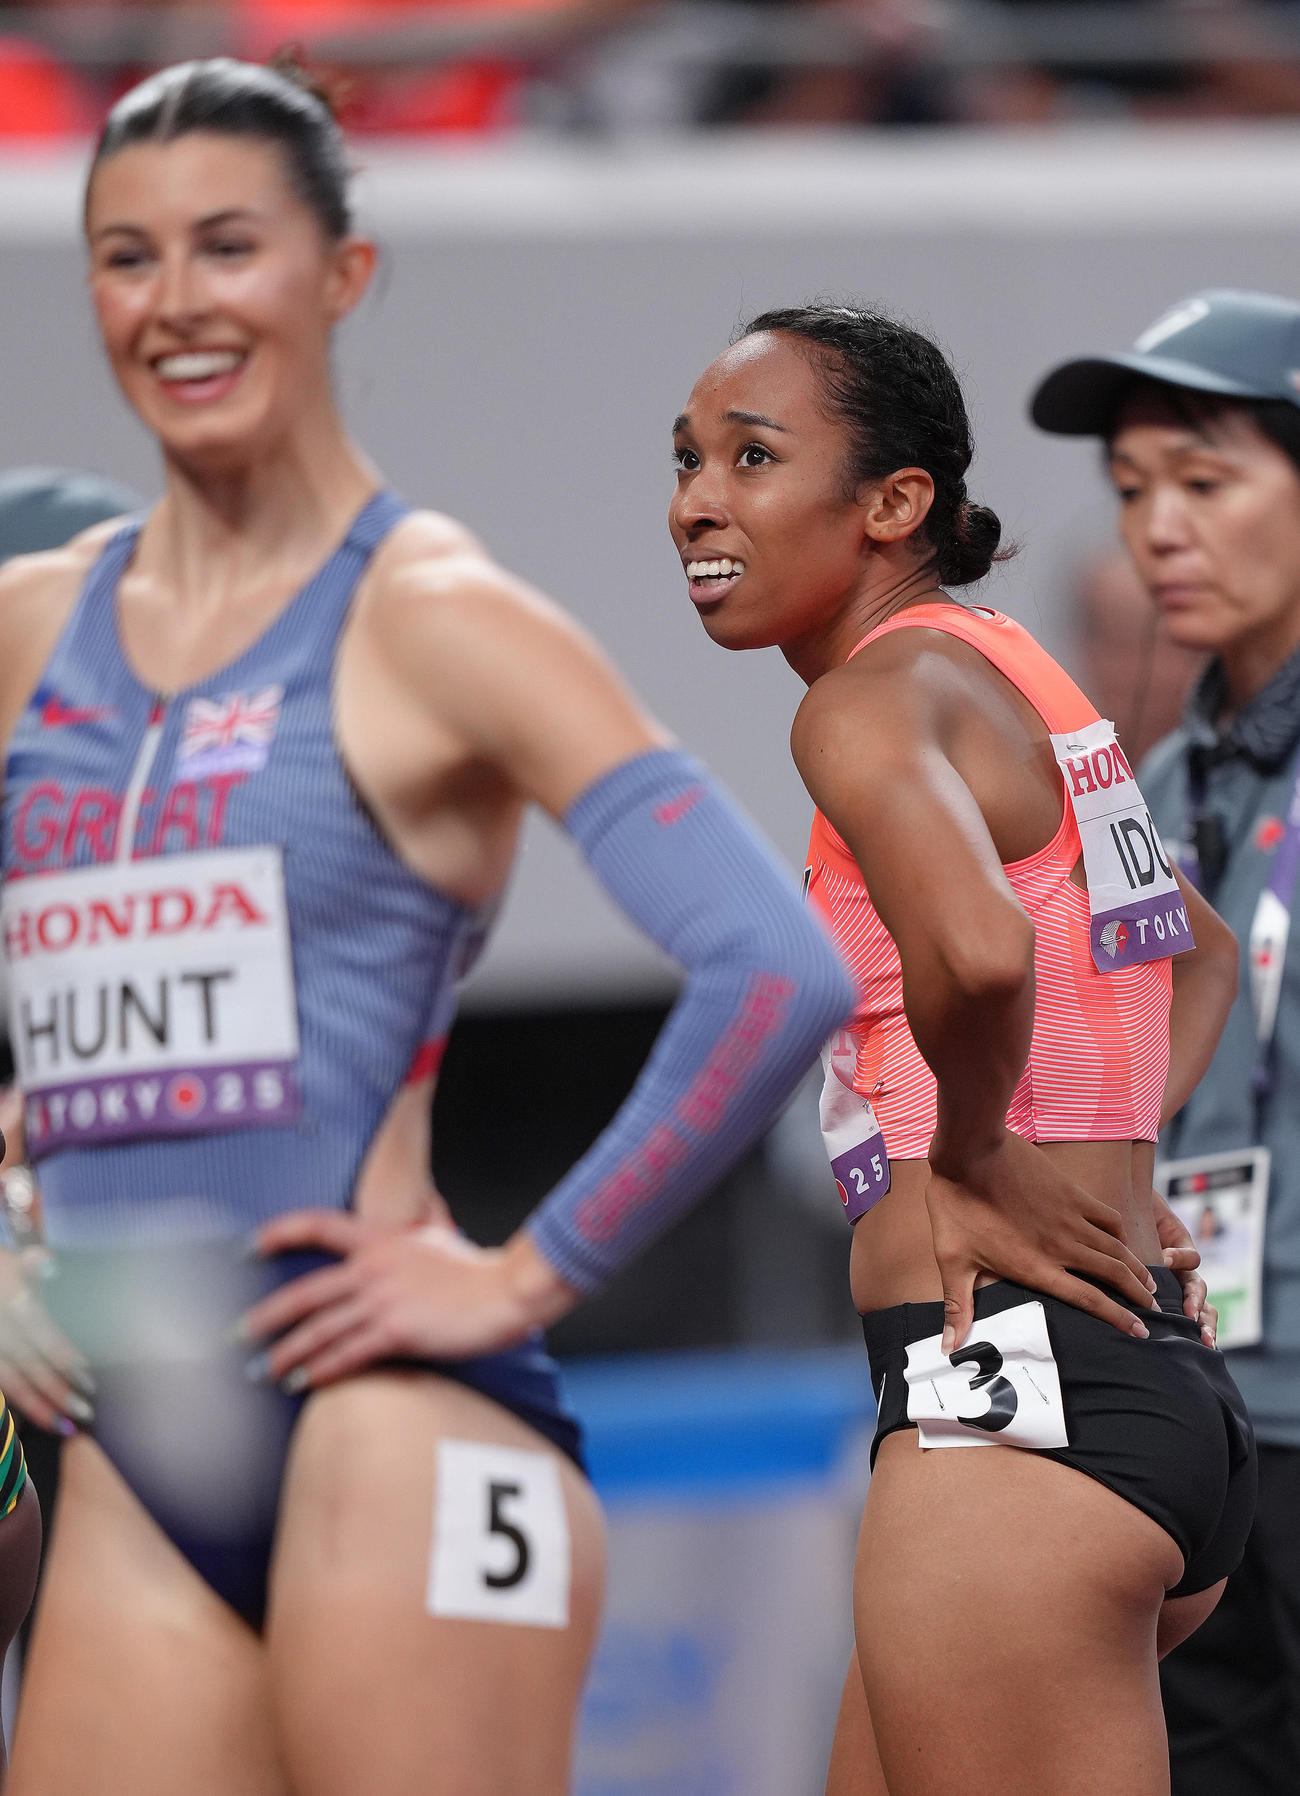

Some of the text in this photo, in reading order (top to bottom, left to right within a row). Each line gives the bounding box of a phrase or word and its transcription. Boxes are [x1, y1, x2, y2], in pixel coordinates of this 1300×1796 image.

[4, 880, 268, 960] HONDA
[20, 968, 235, 1070] HUNT
[850, 1154, 883, 1195] 25
[949, 1341, 1018, 1432] 3
[485, 1481, 530, 1590] 5
